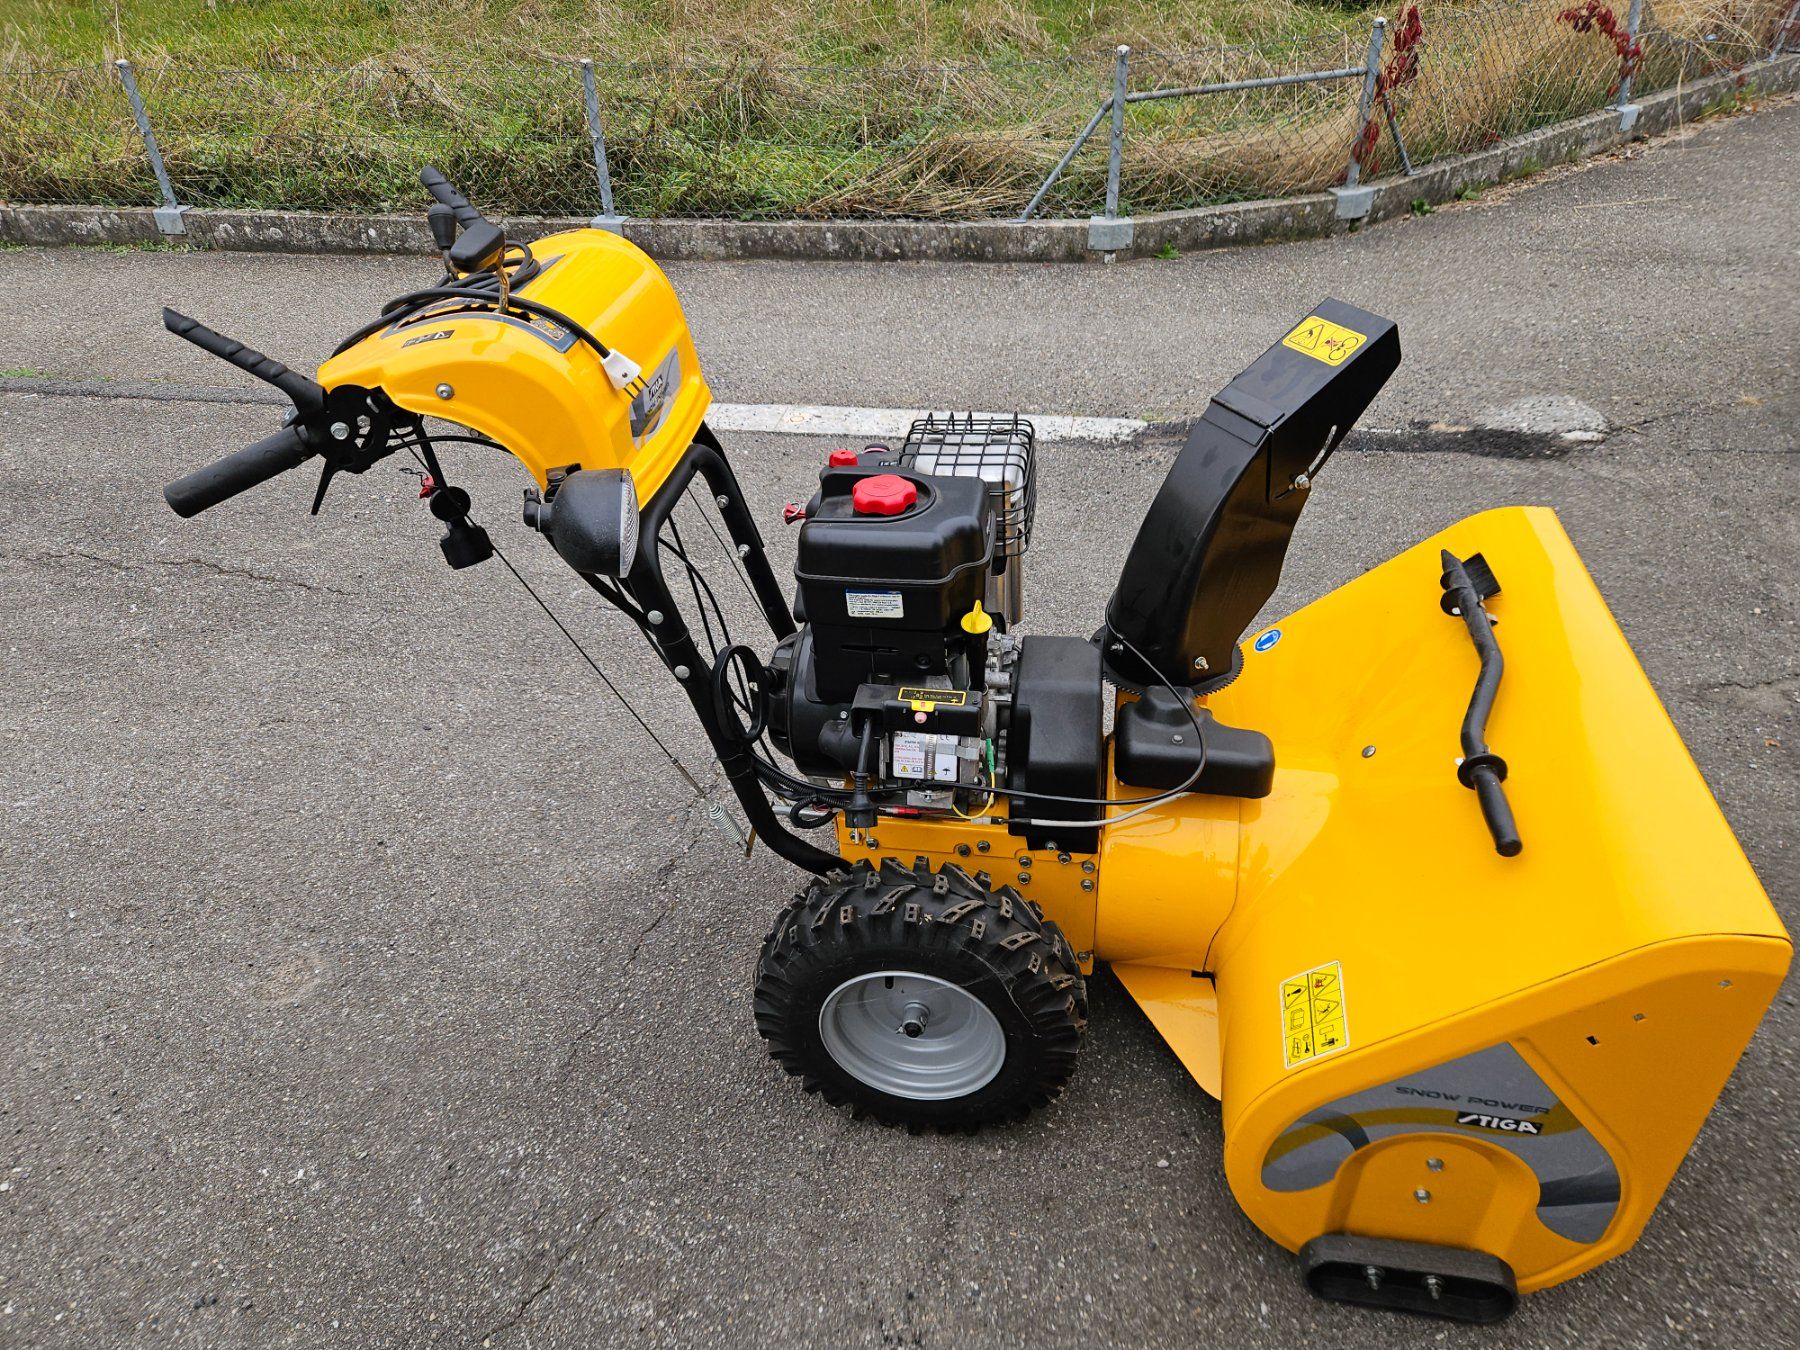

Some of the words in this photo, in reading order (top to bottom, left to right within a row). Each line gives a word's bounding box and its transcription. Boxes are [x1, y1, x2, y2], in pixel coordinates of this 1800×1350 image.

[1395, 1086, 1461, 1102] SNOW
[1467, 1096, 1551, 1114] POWER
[1458, 1113, 1539, 1135] STIGA
